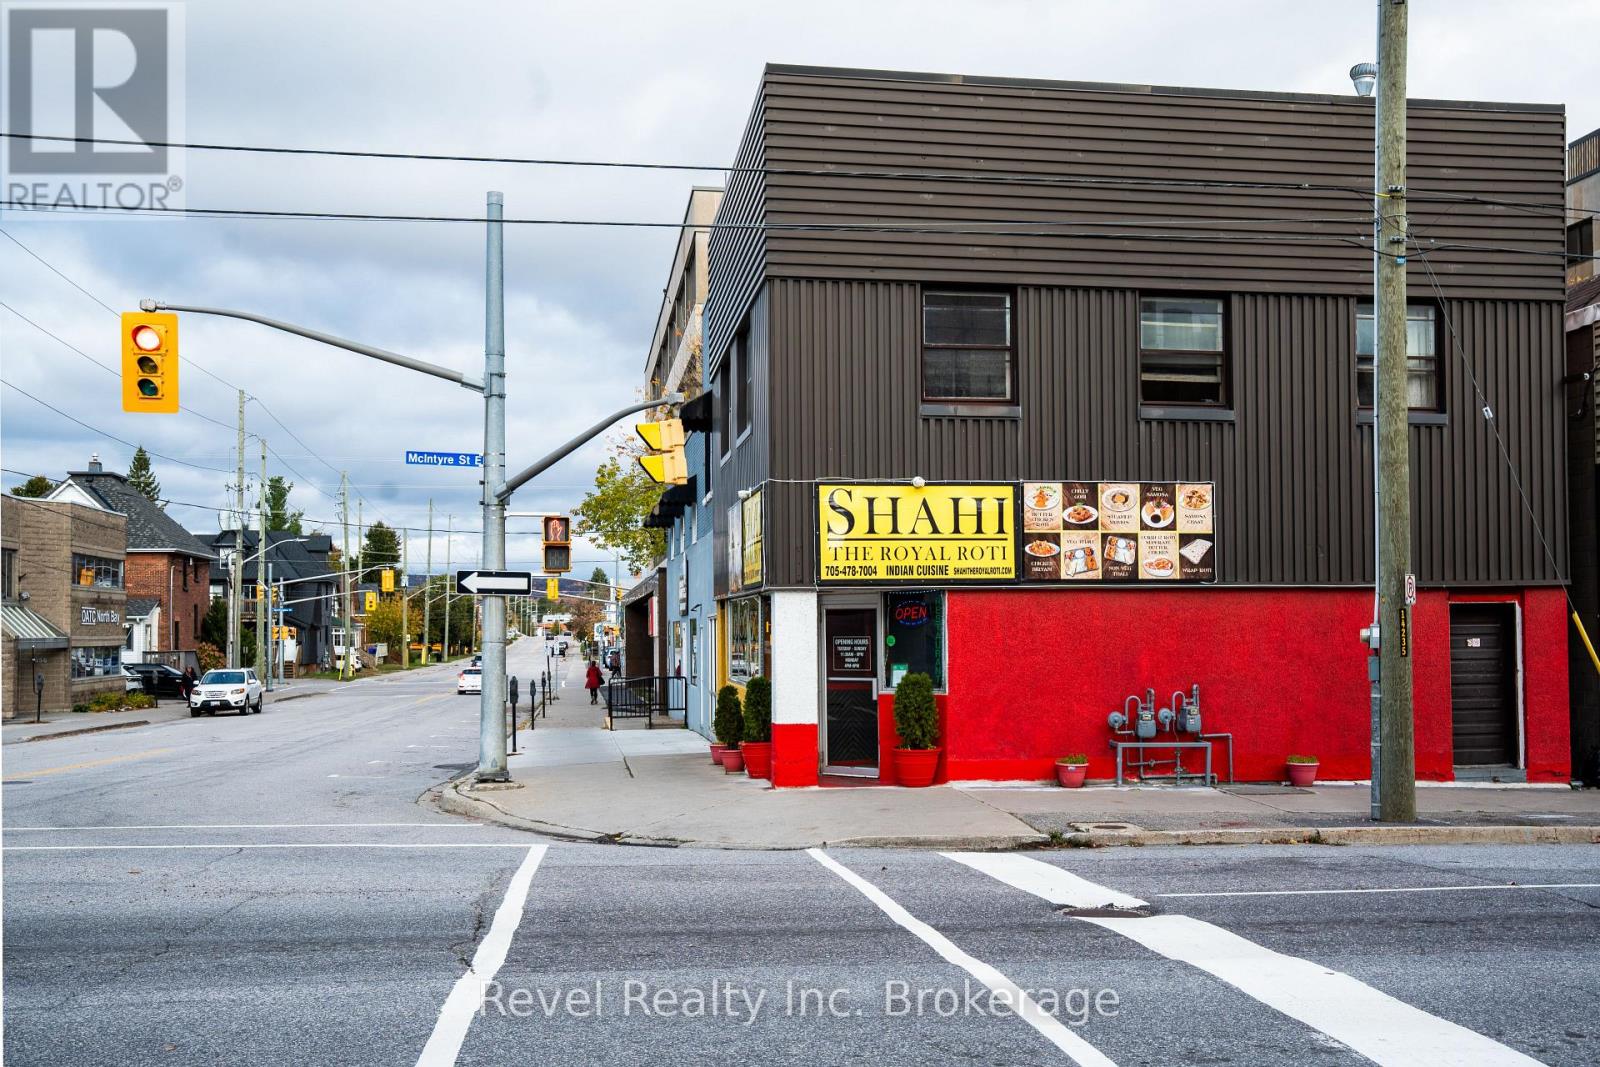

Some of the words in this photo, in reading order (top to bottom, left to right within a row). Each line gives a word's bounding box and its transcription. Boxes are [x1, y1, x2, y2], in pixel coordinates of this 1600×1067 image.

[408, 452, 454, 465] McIntyre
[458, 455, 471, 465] St
[474, 456, 482, 465] E
[827, 488, 1008, 535] SHAHI
[829, 546, 874, 561] THE
[880, 545, 951, 561] ROYAL
[958, 545, 1007, 561] ROTI
[825, 565, 878, 576] 705-478-7004
[886, 565, 915, 576] INDIAN
[917, 565, 949, 576] CUISINE
[82, 609, 96, 623] OATC
[97, 610, 110, 623] North
[110, 610, 120, 625] Bay
[896, 606, 927, 620] OPEN
